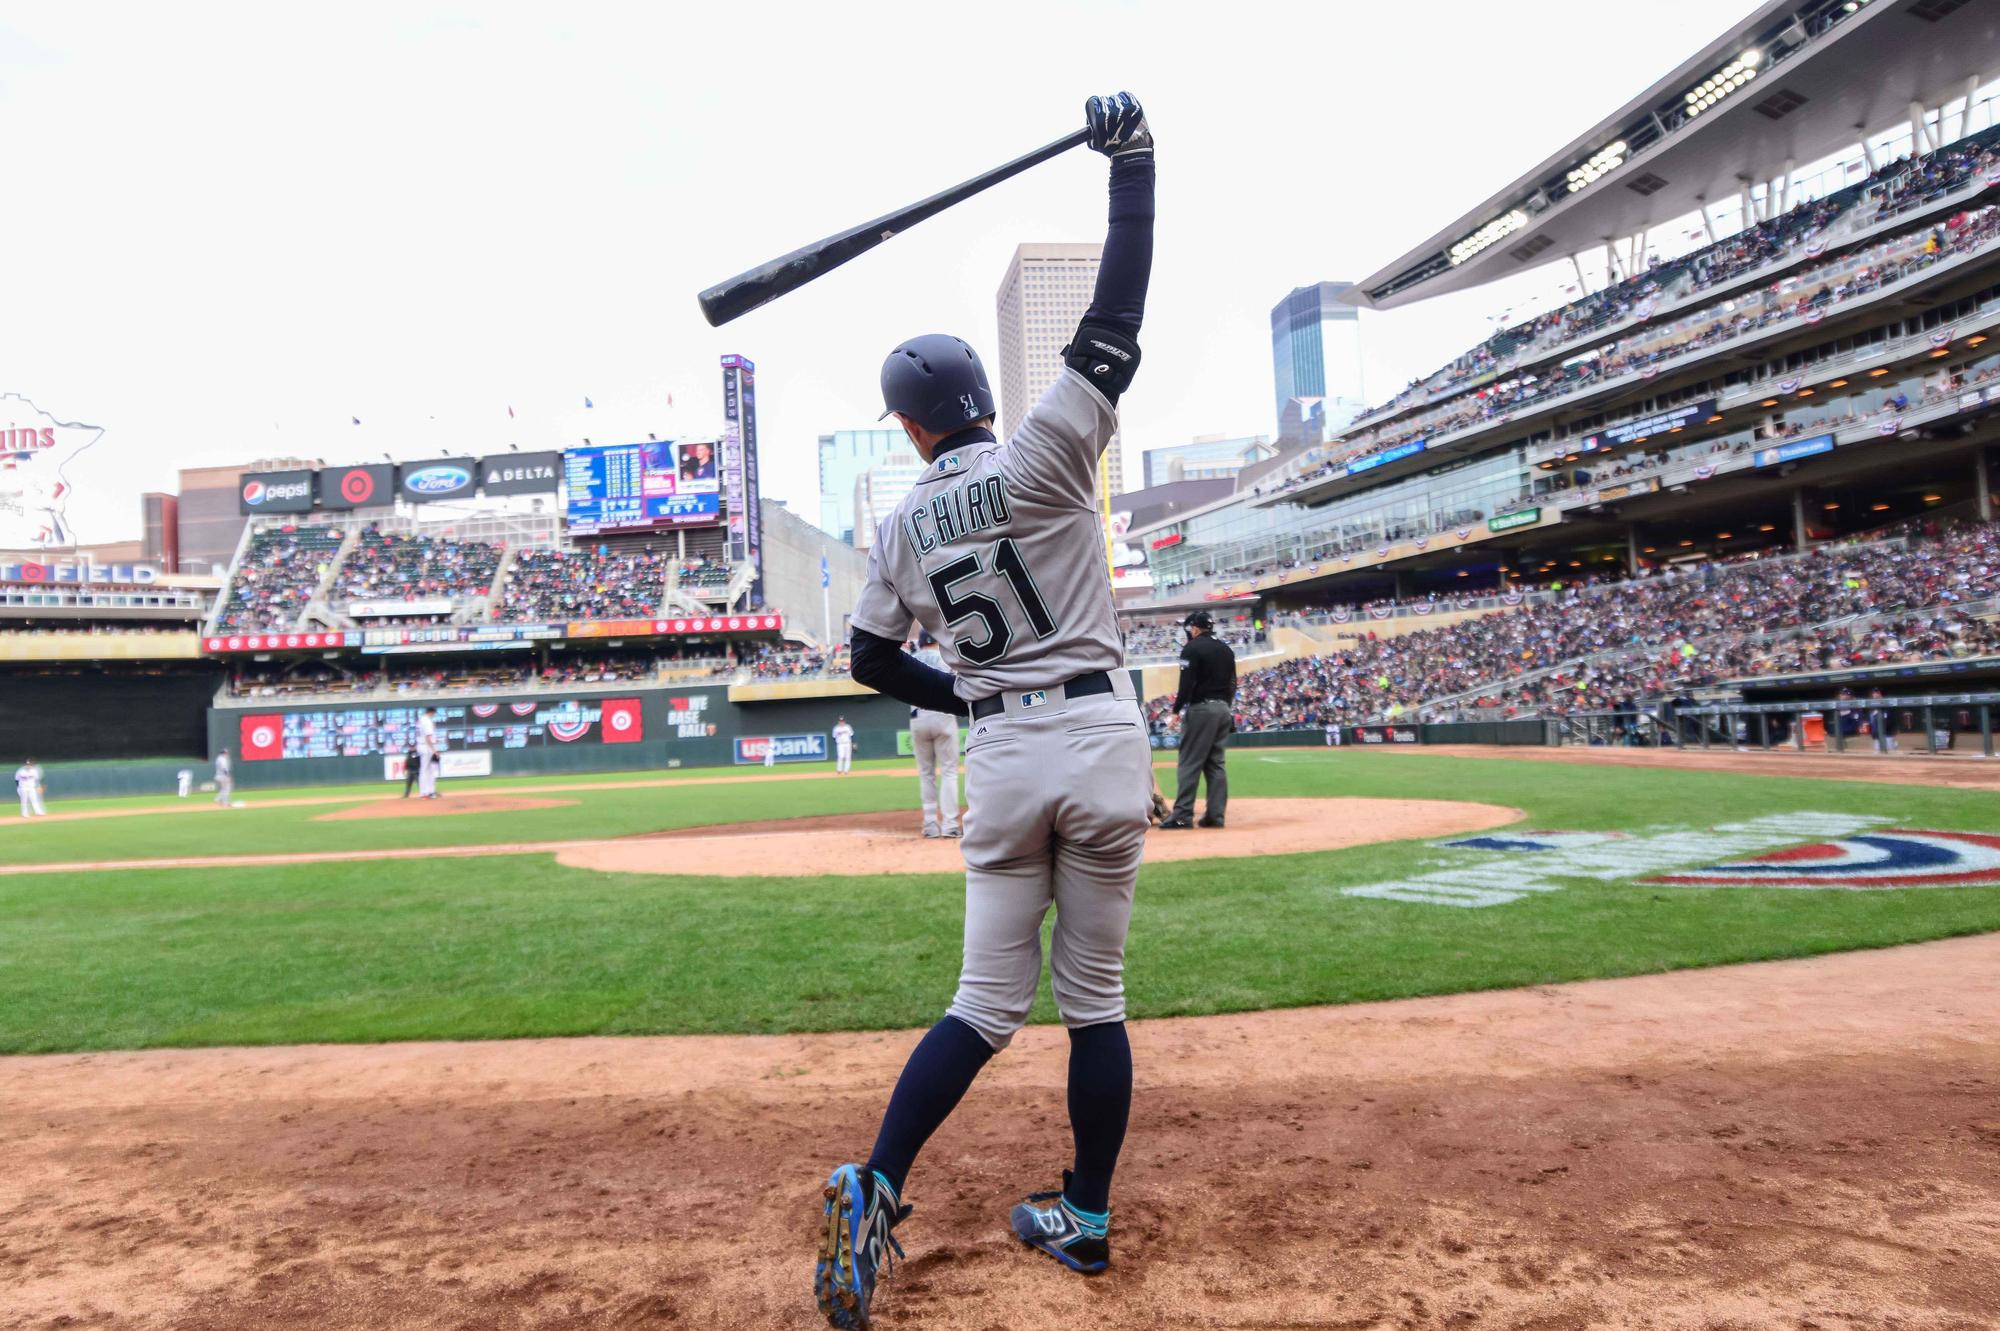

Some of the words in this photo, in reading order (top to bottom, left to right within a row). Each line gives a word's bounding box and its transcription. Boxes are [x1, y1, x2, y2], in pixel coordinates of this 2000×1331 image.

[960, 393, 974, 410] 51
[0, 422, 55, 450] ins
[418, 474, 457, 490] Ford
[503, 466, 554, 481] DELTA
[266, 482, 308, 502] pepsi
[903, 472, 1012, 563] ICHIRO
[54, 563, 157, 584] FIELD
[926, 536, 1058, 668] 51
[688, 695, 709, 711] WE
[535, 710, 580, 725] OPENING
[581, 708, 602, 723] DAY
[667, 710, 700, 726] BASE
[678, 723, 707, 738] BALL
